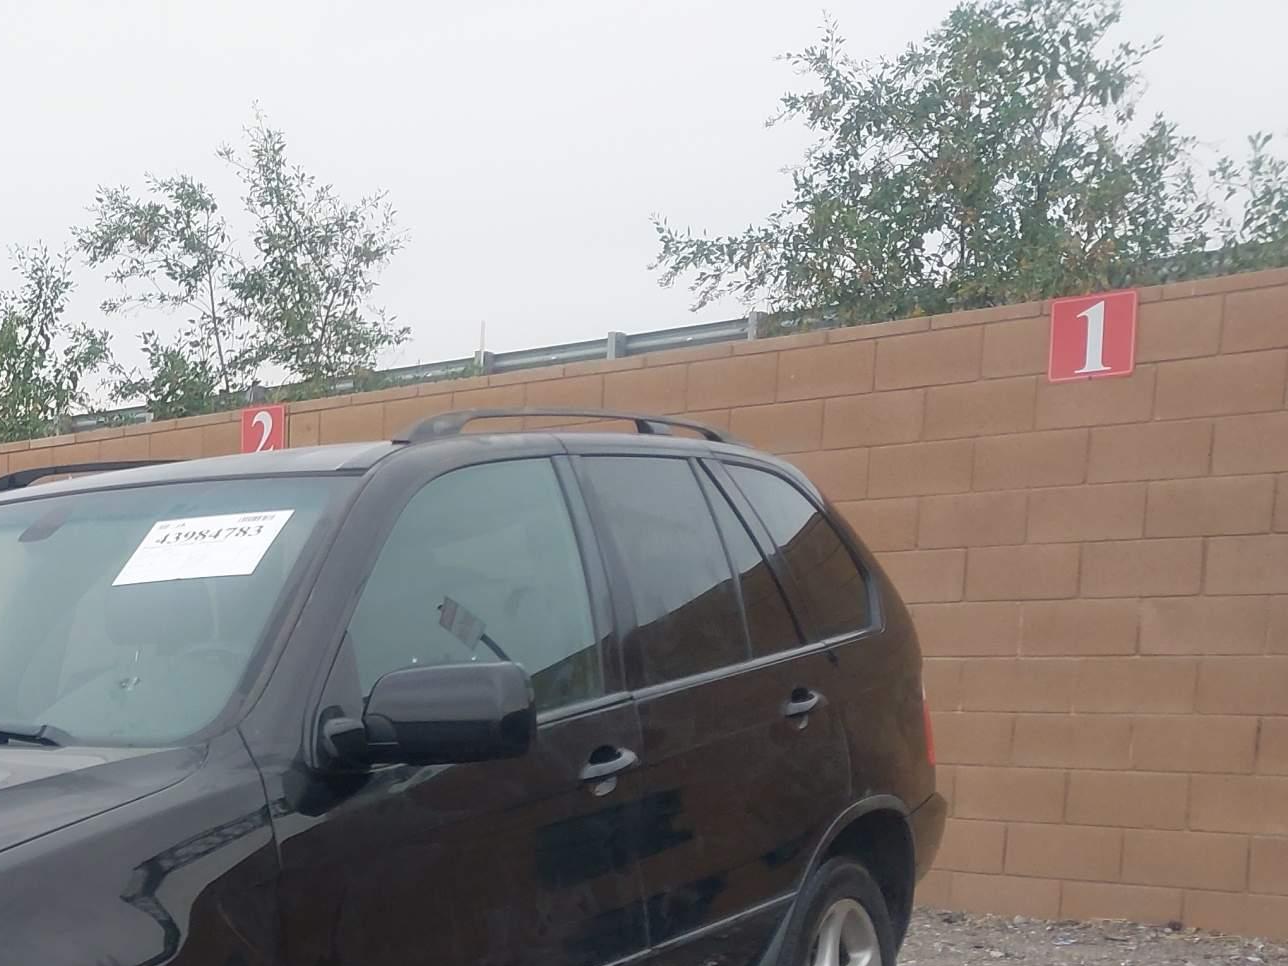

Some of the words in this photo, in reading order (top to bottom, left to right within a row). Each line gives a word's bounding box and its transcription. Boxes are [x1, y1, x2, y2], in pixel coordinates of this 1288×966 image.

[1074, 300, 1112, 374] 1
[251, 410, 274, 452] 2
[155, 525, 265, 545] 43984783
